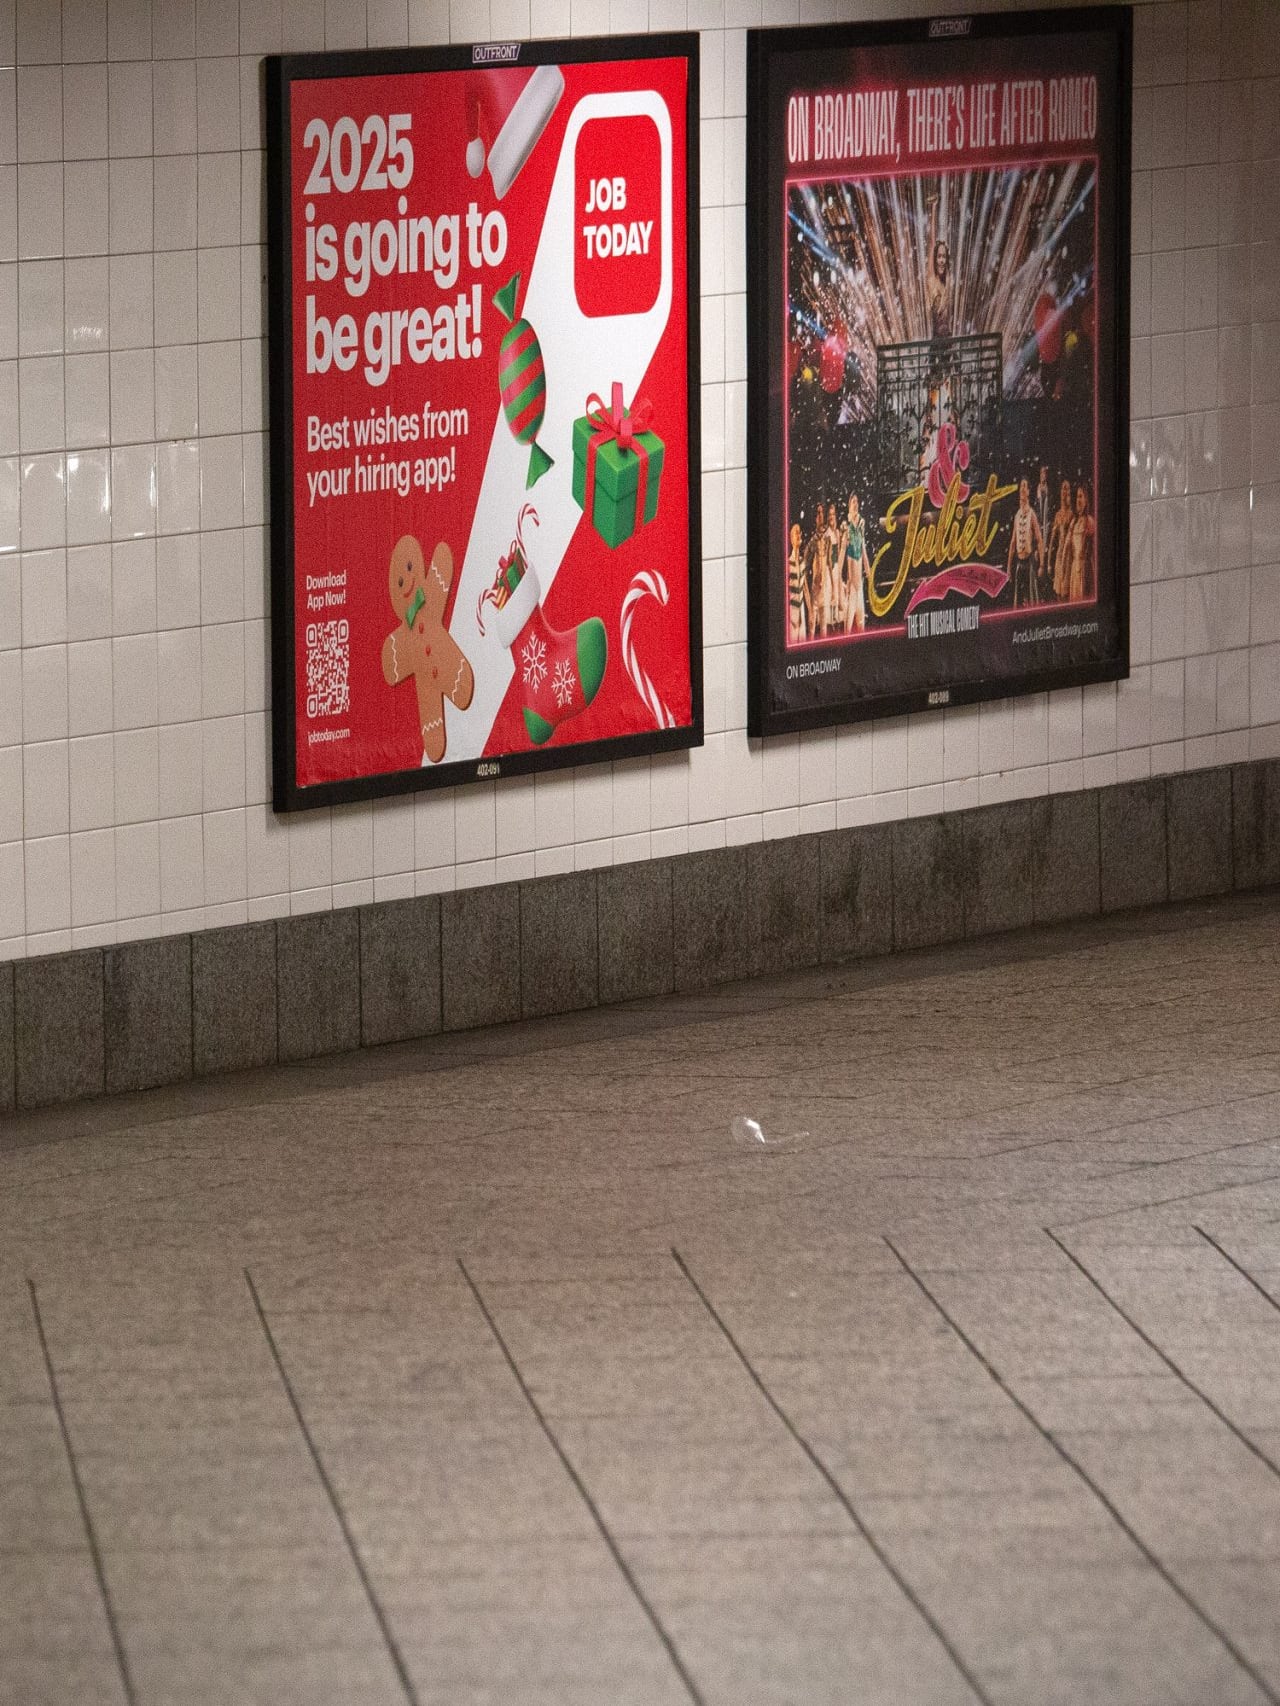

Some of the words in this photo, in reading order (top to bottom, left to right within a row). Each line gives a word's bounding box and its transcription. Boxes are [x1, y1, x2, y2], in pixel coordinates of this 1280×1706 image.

[474, 45, 518, 60] OUTFRONT
[788, 96, 809, 163] ON
[814, 90, 900, 163] BROADWAY,
[907, 85, 965, 152] THERE'S
[970, 83, 997, 148] LIFE
[1000, 79, 1043, 145] AFTER
[1048, 75, 1097, 142] ROMEO
[303, 113, 414, 195] 2025
[585, 177, 627, 213] JOB
[306, 202, 338, 282] is
[344, 195, 460, 297] going
[467, 202, 508, 268] to
[583, 221, 653, 258] TODAY
[306, 294, 359, 374] be
[364, 284, 482, 387] great!
[307, 415, 350, 452] Best
[353, 405, 420, 447] wishes
[423, 401, 469, 439] from
[307, 467, 351, 507] your
[355, 453, 410, 497] hiring
[414, 446, 456, 493] app!
[868, 471, 1018, 618] Juliet
[306, 570, 346, 590] Download
[307, 594, 324, 611] App
[325, 590, 346, 606] Now!
[907, 613, 919, 639] THE
[919, 612, 929, 637] HIT
[930, 607, 955, 636] MUSICAL
[786, 664, 798, 679] ON
[799, 658, 842, 677] BROADWAY
[308, 728, 350, 746] jobtoday.com
